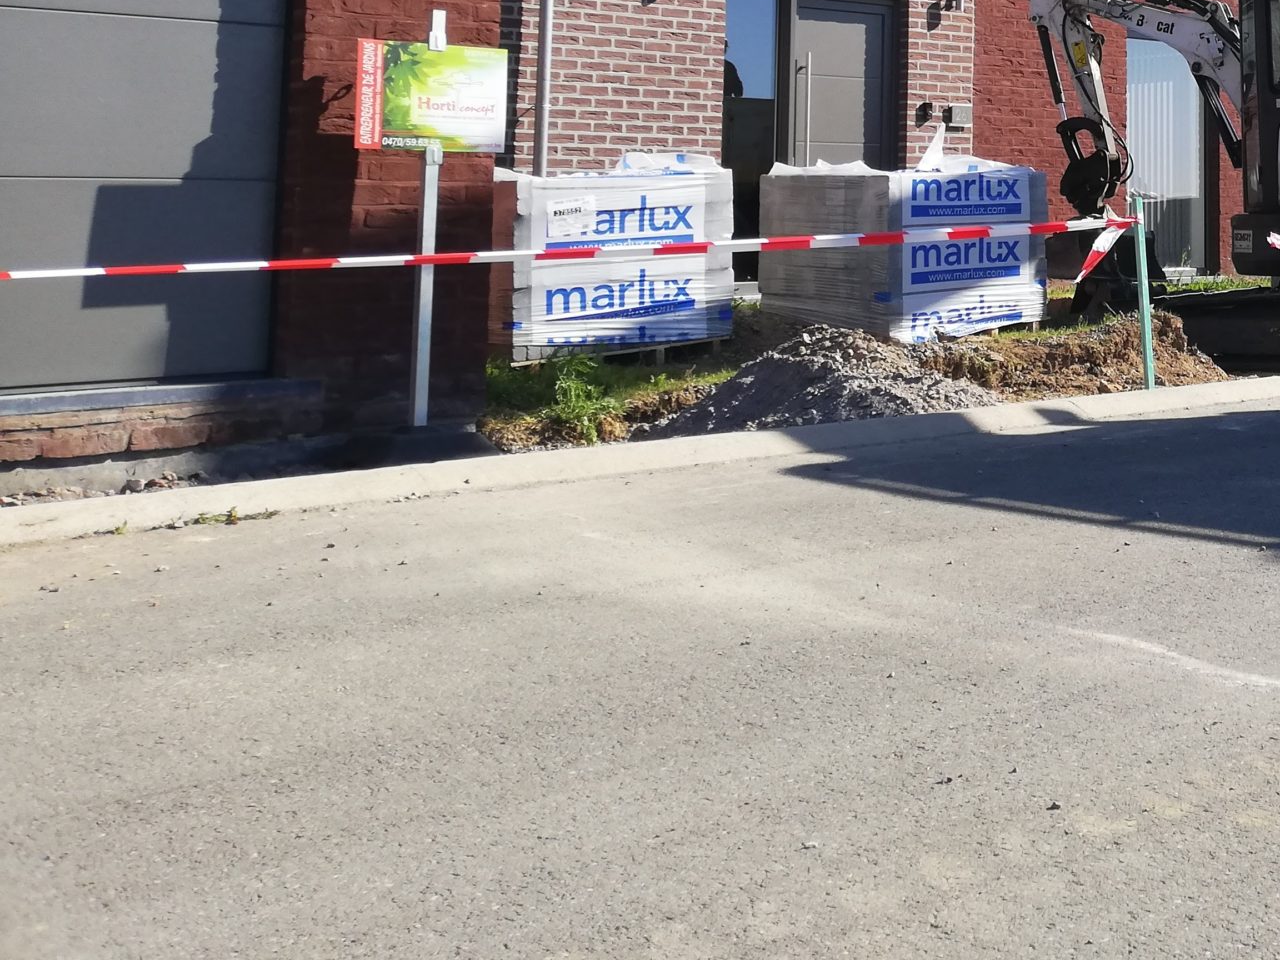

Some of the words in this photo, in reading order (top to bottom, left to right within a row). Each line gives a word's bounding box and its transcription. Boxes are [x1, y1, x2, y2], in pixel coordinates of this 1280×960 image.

[362, 42, 376, 73] JARDINS
[362, 74, 374, 85] DE
[359, 86, 375, 145] ENTREPRENEUR
[417, 96, 456, 112] Horti
[910, 173, 1021, 202] marlux
[547, 195, 694, 237] arlux
[928, 206, 1006, 217] www.marlux.com
[910, 238, 1021, 269] marlux
[928, 269, 1006, 282] www.marlux.com
[545, 268, 694, 316] marlux
